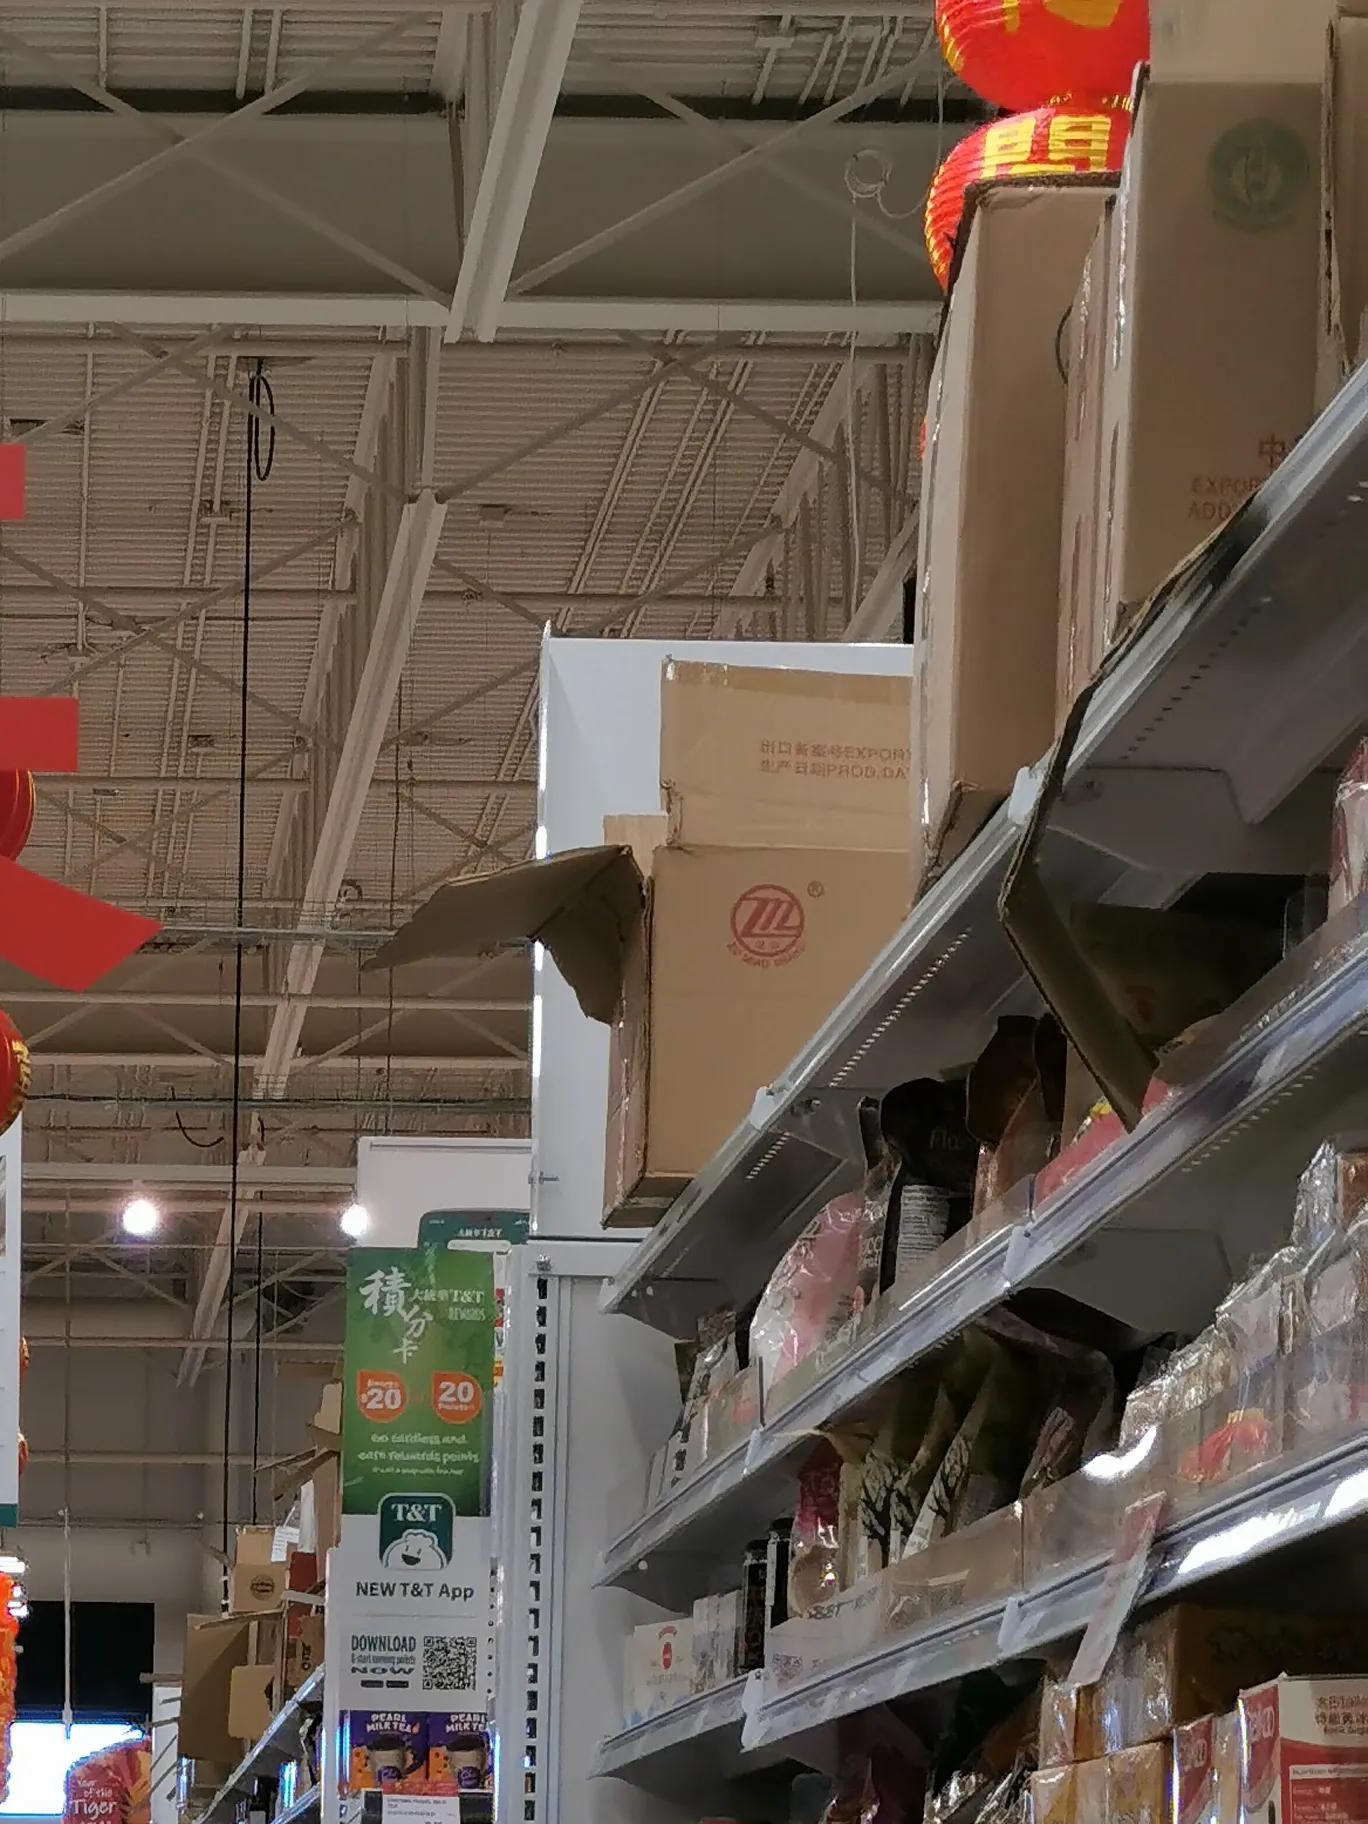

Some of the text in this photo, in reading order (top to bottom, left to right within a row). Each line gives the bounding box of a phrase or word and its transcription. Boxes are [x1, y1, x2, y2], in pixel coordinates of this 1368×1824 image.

[439, 1381, 474, 1403] 20
[390, 1503, 443, 1522] T&T
[355, 1581, 475, 1602] NEW T&T App
[351, 1634, 417, 1652] DOWNLOAD
[350, 1666, 415, 1675] NOW
[366, 1721, 393, 1733] MILK
[371, 1713, 407, 1723] PEARL
[445, 1722, 472, 1733] MILK
[69, 1799, 118, 1821] Tiger
